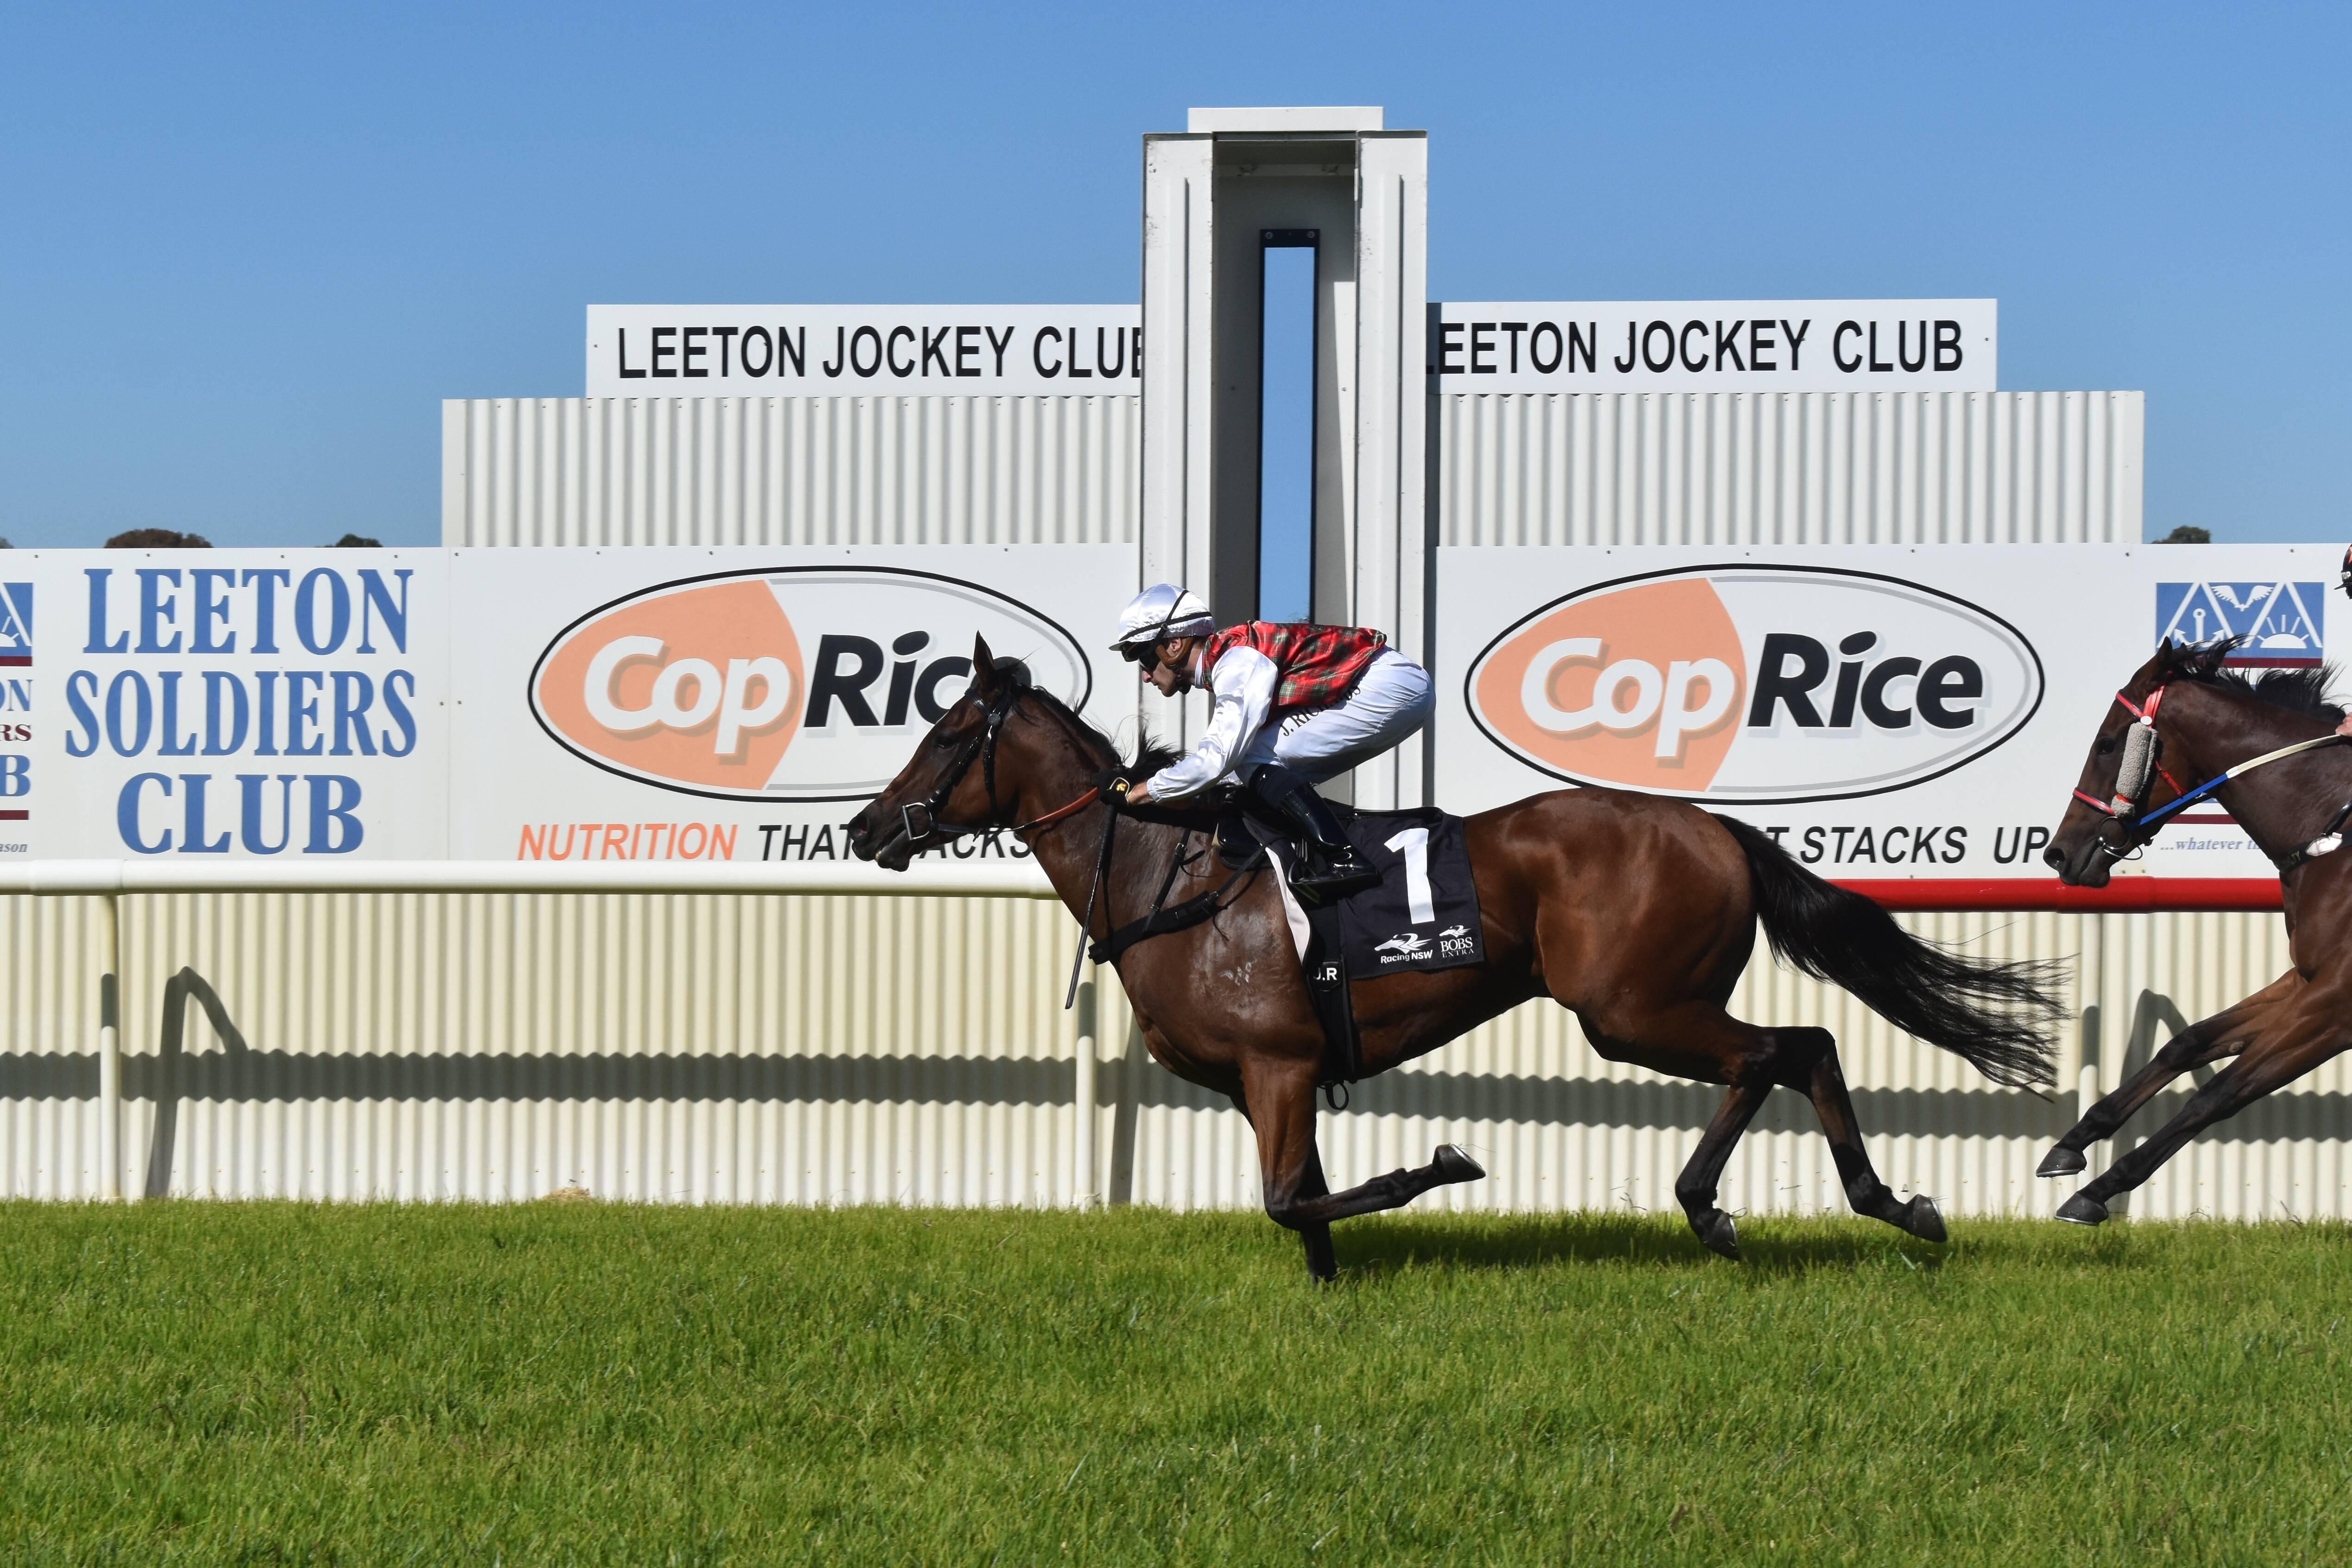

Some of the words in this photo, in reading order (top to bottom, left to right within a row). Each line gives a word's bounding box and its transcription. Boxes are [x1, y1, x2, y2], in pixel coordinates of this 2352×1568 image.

[619, 325, 805, 379] LEETON
[822, 325, 1014, 378] JOCKEY
[1426, 319, 1596, 374] EETON
[1614, 319, 1811, 373] JOCKEY
[1833, 320, 1963, 373] CLUB
[83, 567, 413, 656] LEETON
[66, 669, 417, 757] SOLDIERS
[117, 773, 364, 855] CLUB
[518, 823, 738, 861] NUTRITION
[1800, 826, 1967, 864] STACKS
[1994, 826, 2049, 864] UP
[1384, 828, 1435, 924] 1
[1381, 953, 1410, 963] Racing
[1411, 950, 1433, 960] NSW
[1440, 937, 1473, 952] BOBS
[1442, 949, 1475, 958] EXTRA
[1314, 967, 1338, 981] J.R
